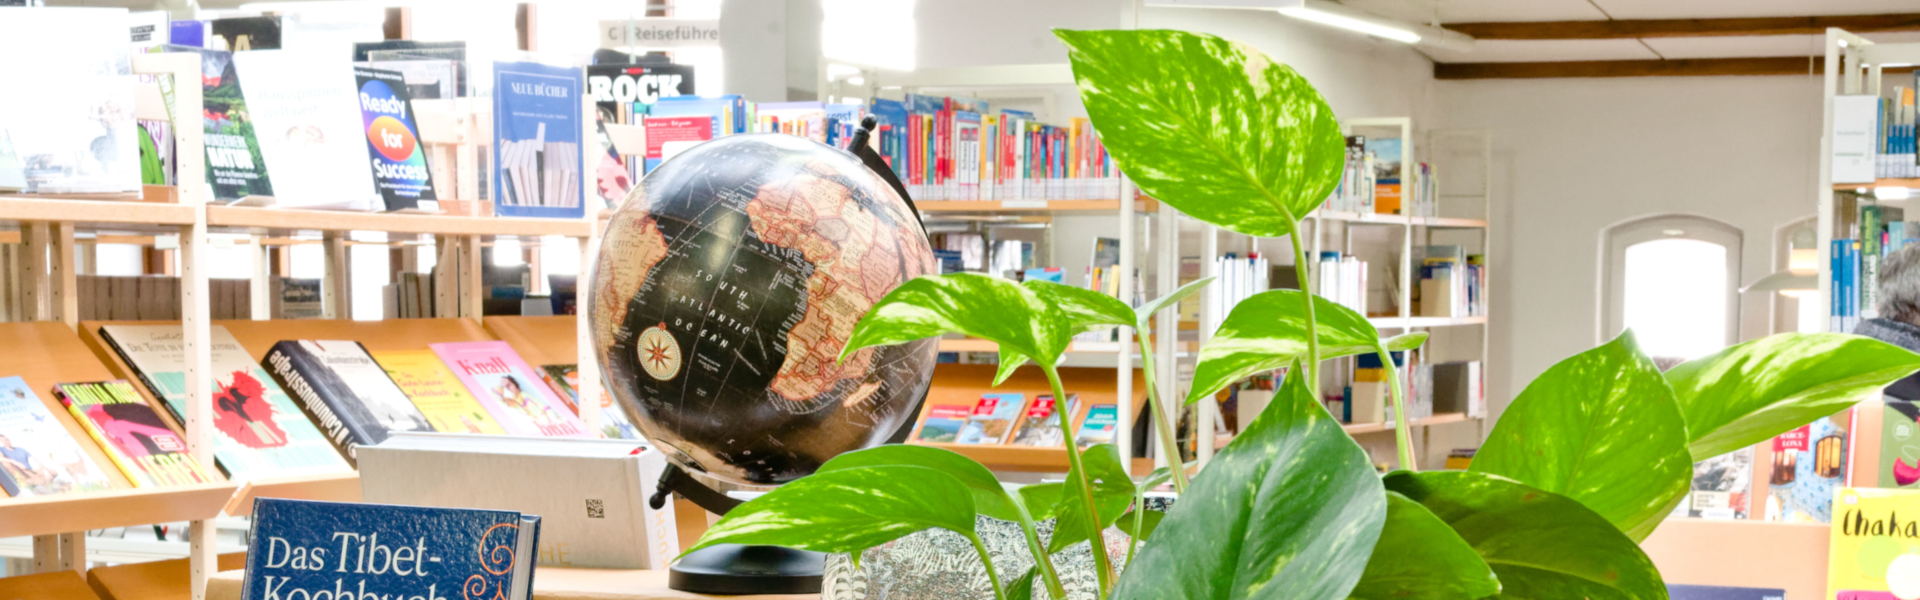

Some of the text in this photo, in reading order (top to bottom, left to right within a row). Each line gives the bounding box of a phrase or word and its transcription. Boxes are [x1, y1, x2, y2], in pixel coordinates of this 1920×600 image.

[608, 24, 718, 42] C Reiseführe
[511, 82, 568, 99] NEUE BÜCHER
[588, 74, 682, 105] ROCK
[359, 91, 406, 120] Ready
[380, 127, 403, 149] for
[206, 147, 255, 170] NATUR
[373, 158, 429, 181] Success
[695, 269, 749, 301] SOUTH
[679, 295, 751, 335] ATLANTIC
[674, 318, 729, 348] OCEAN
[456, 356, 512, 376] Knall
[269, 350, 343, 439] Columbusstraße
[1782, 440, 1803, 448] LONA
[655, 511, 671, 571] KÜCH
[264, 531, 442, 577] Das Tibet-
[538, 542, 572, 566] HE
[261, 575, 449, 600] Kochbuch
